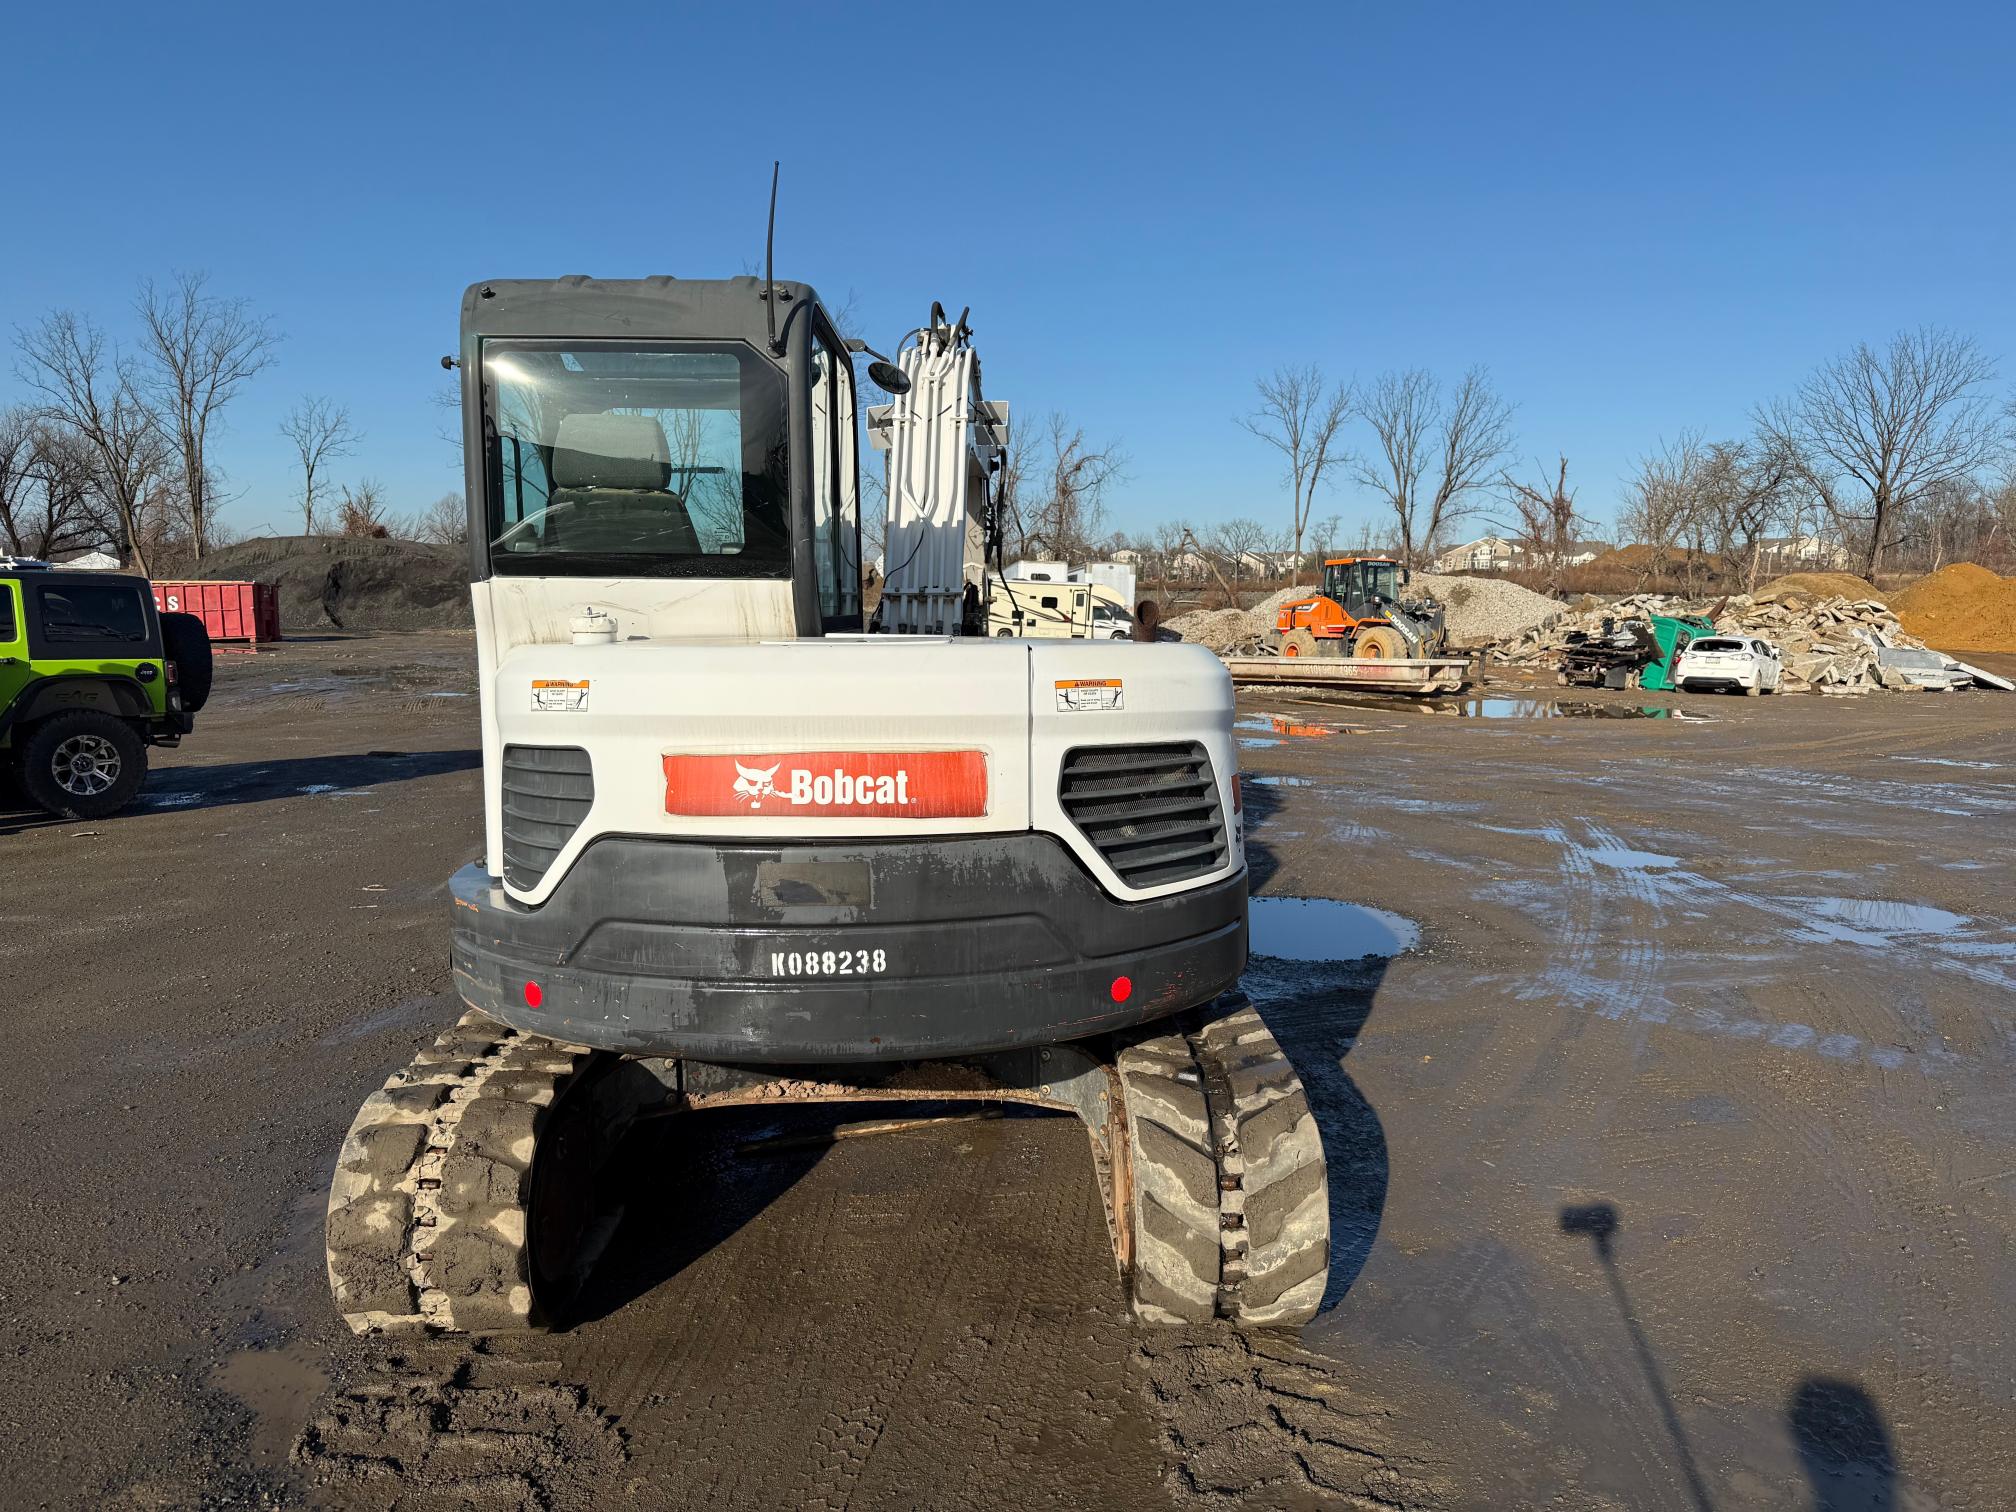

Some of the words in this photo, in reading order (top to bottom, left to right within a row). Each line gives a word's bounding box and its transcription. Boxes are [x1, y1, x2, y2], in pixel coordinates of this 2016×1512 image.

[1390, 614, 1419, 644] DOOSAN
[791, 768, 909, 805] Bobcat
[771, 949, 887, 976] K088238
